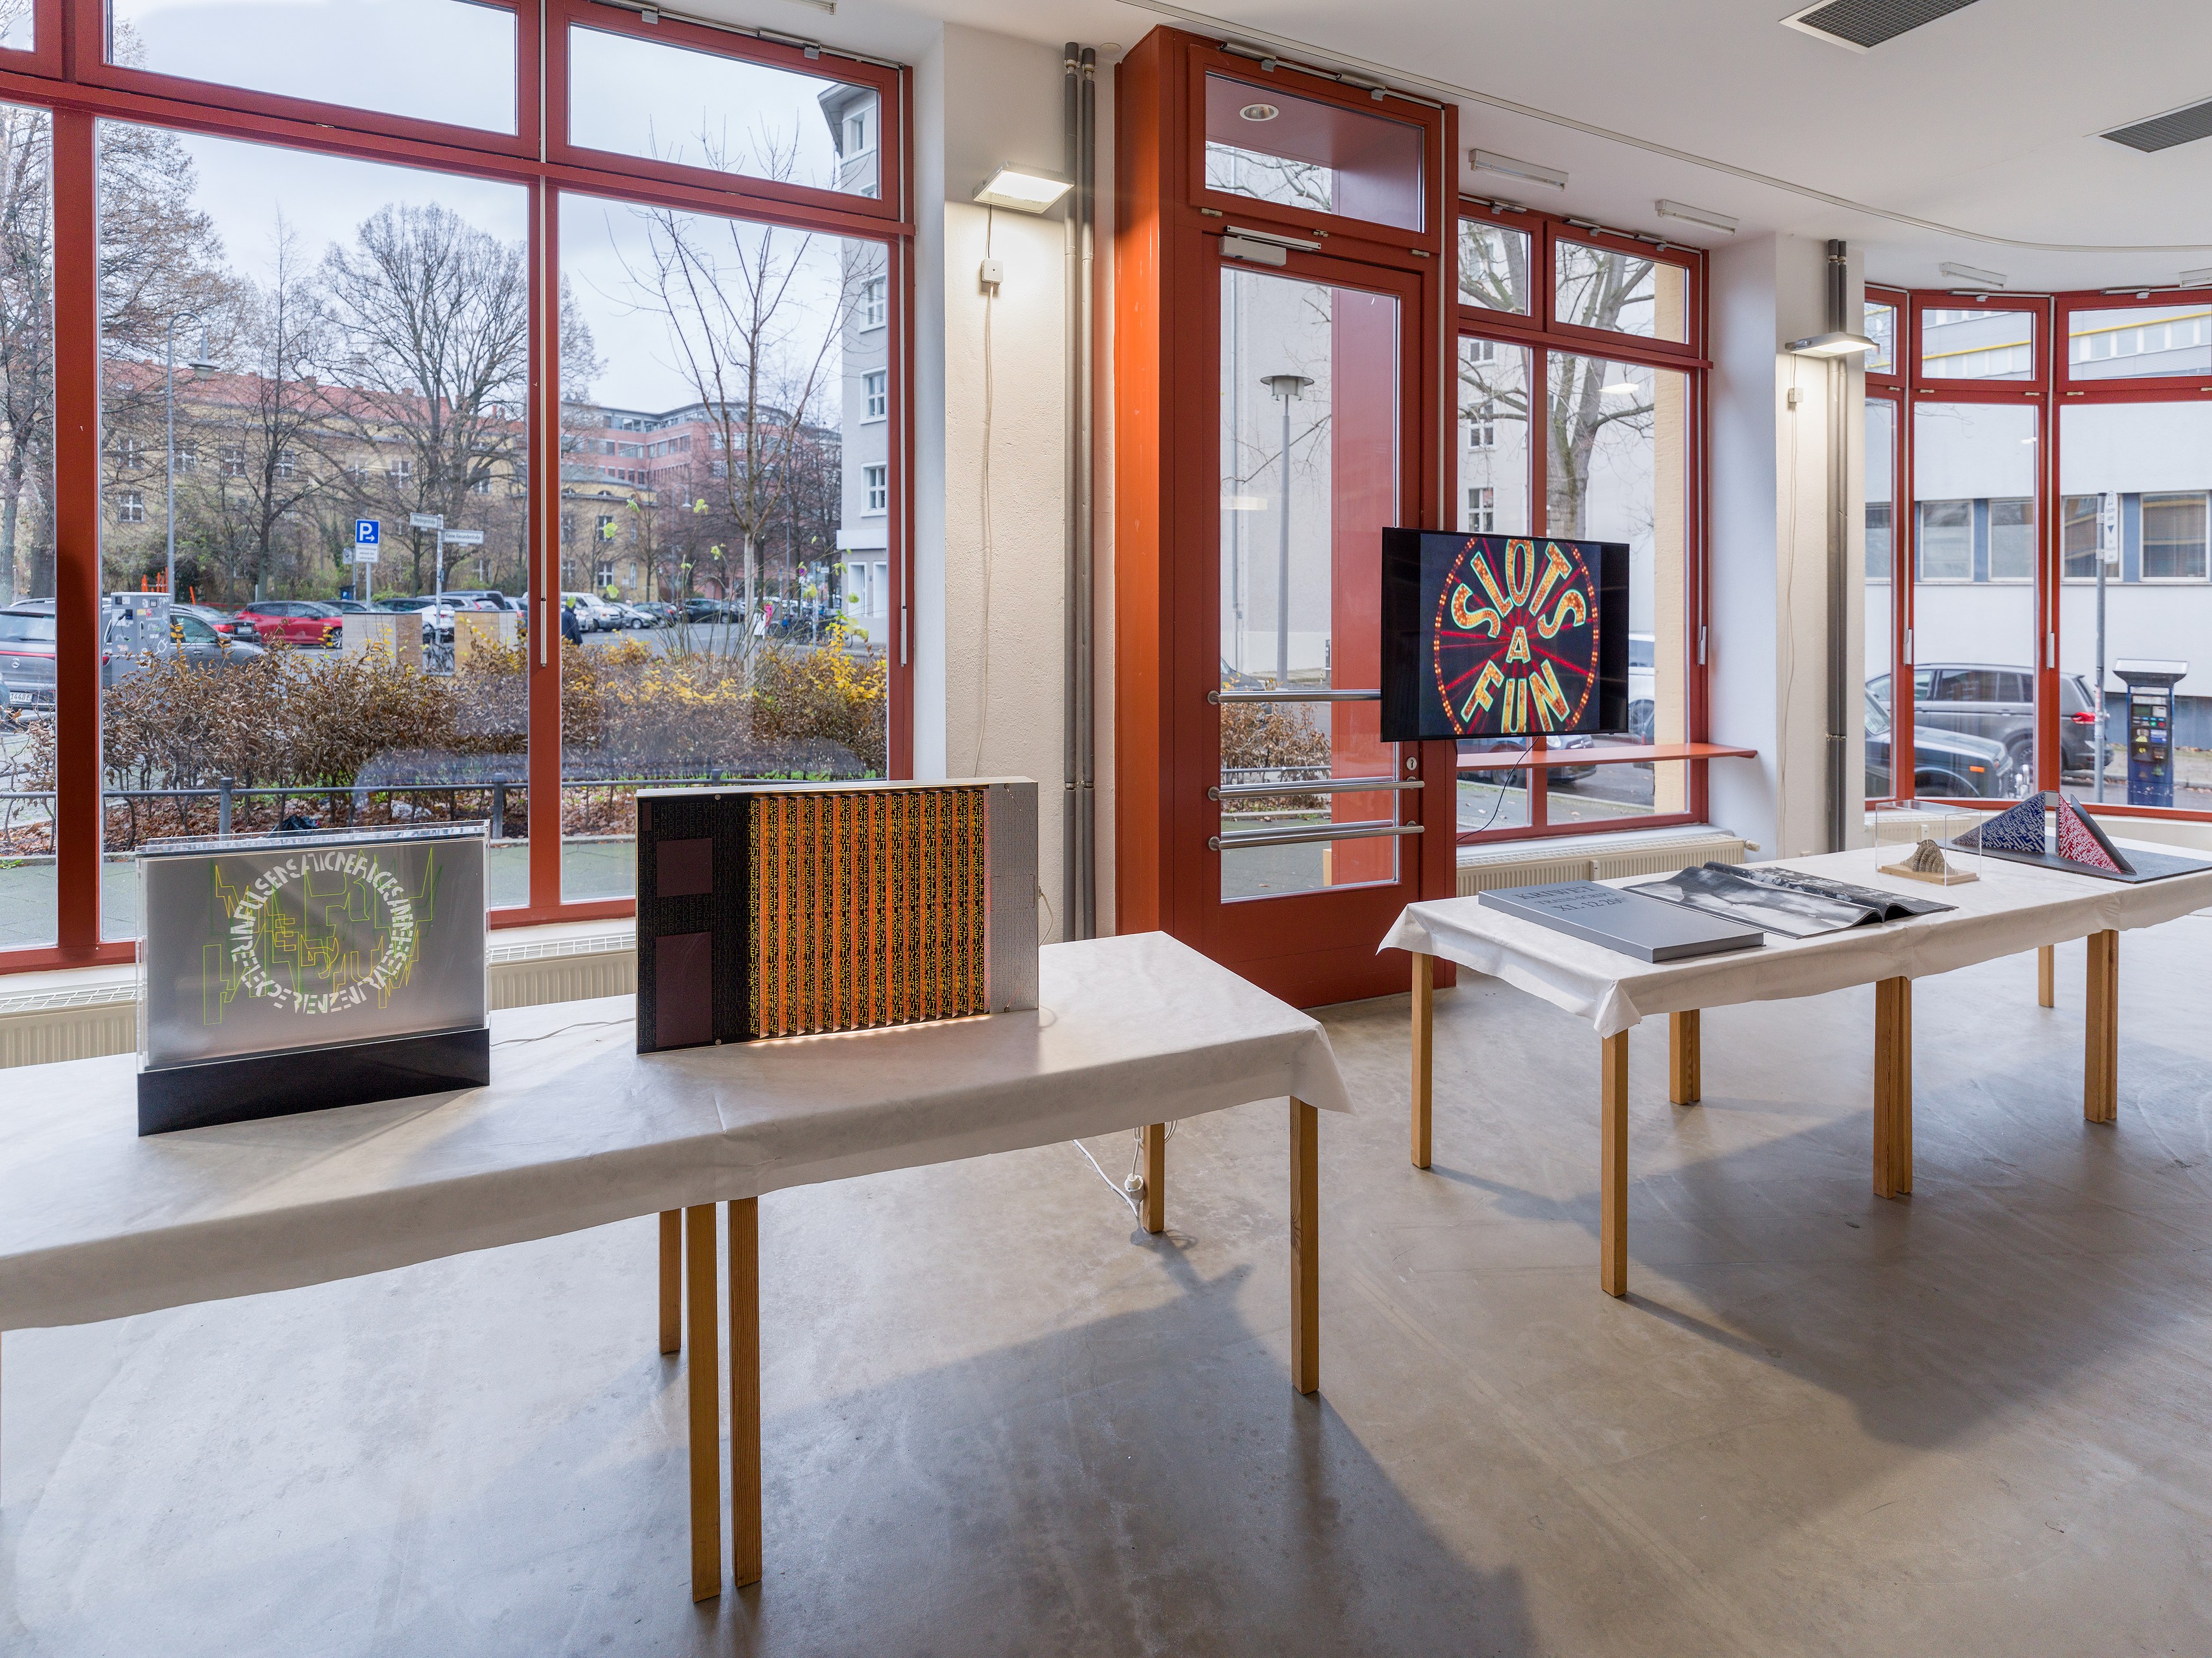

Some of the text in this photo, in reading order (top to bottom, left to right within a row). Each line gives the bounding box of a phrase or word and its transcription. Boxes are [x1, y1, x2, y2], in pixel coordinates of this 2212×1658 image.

[360, 523, 372, 541] P
[1451, 538, 1586, 639] SLOTS
[1506, 626, 1531, 663] A
[1461, 659, 1571, 734] FUN
[1512, 886, 1596, 899] KRIWET
